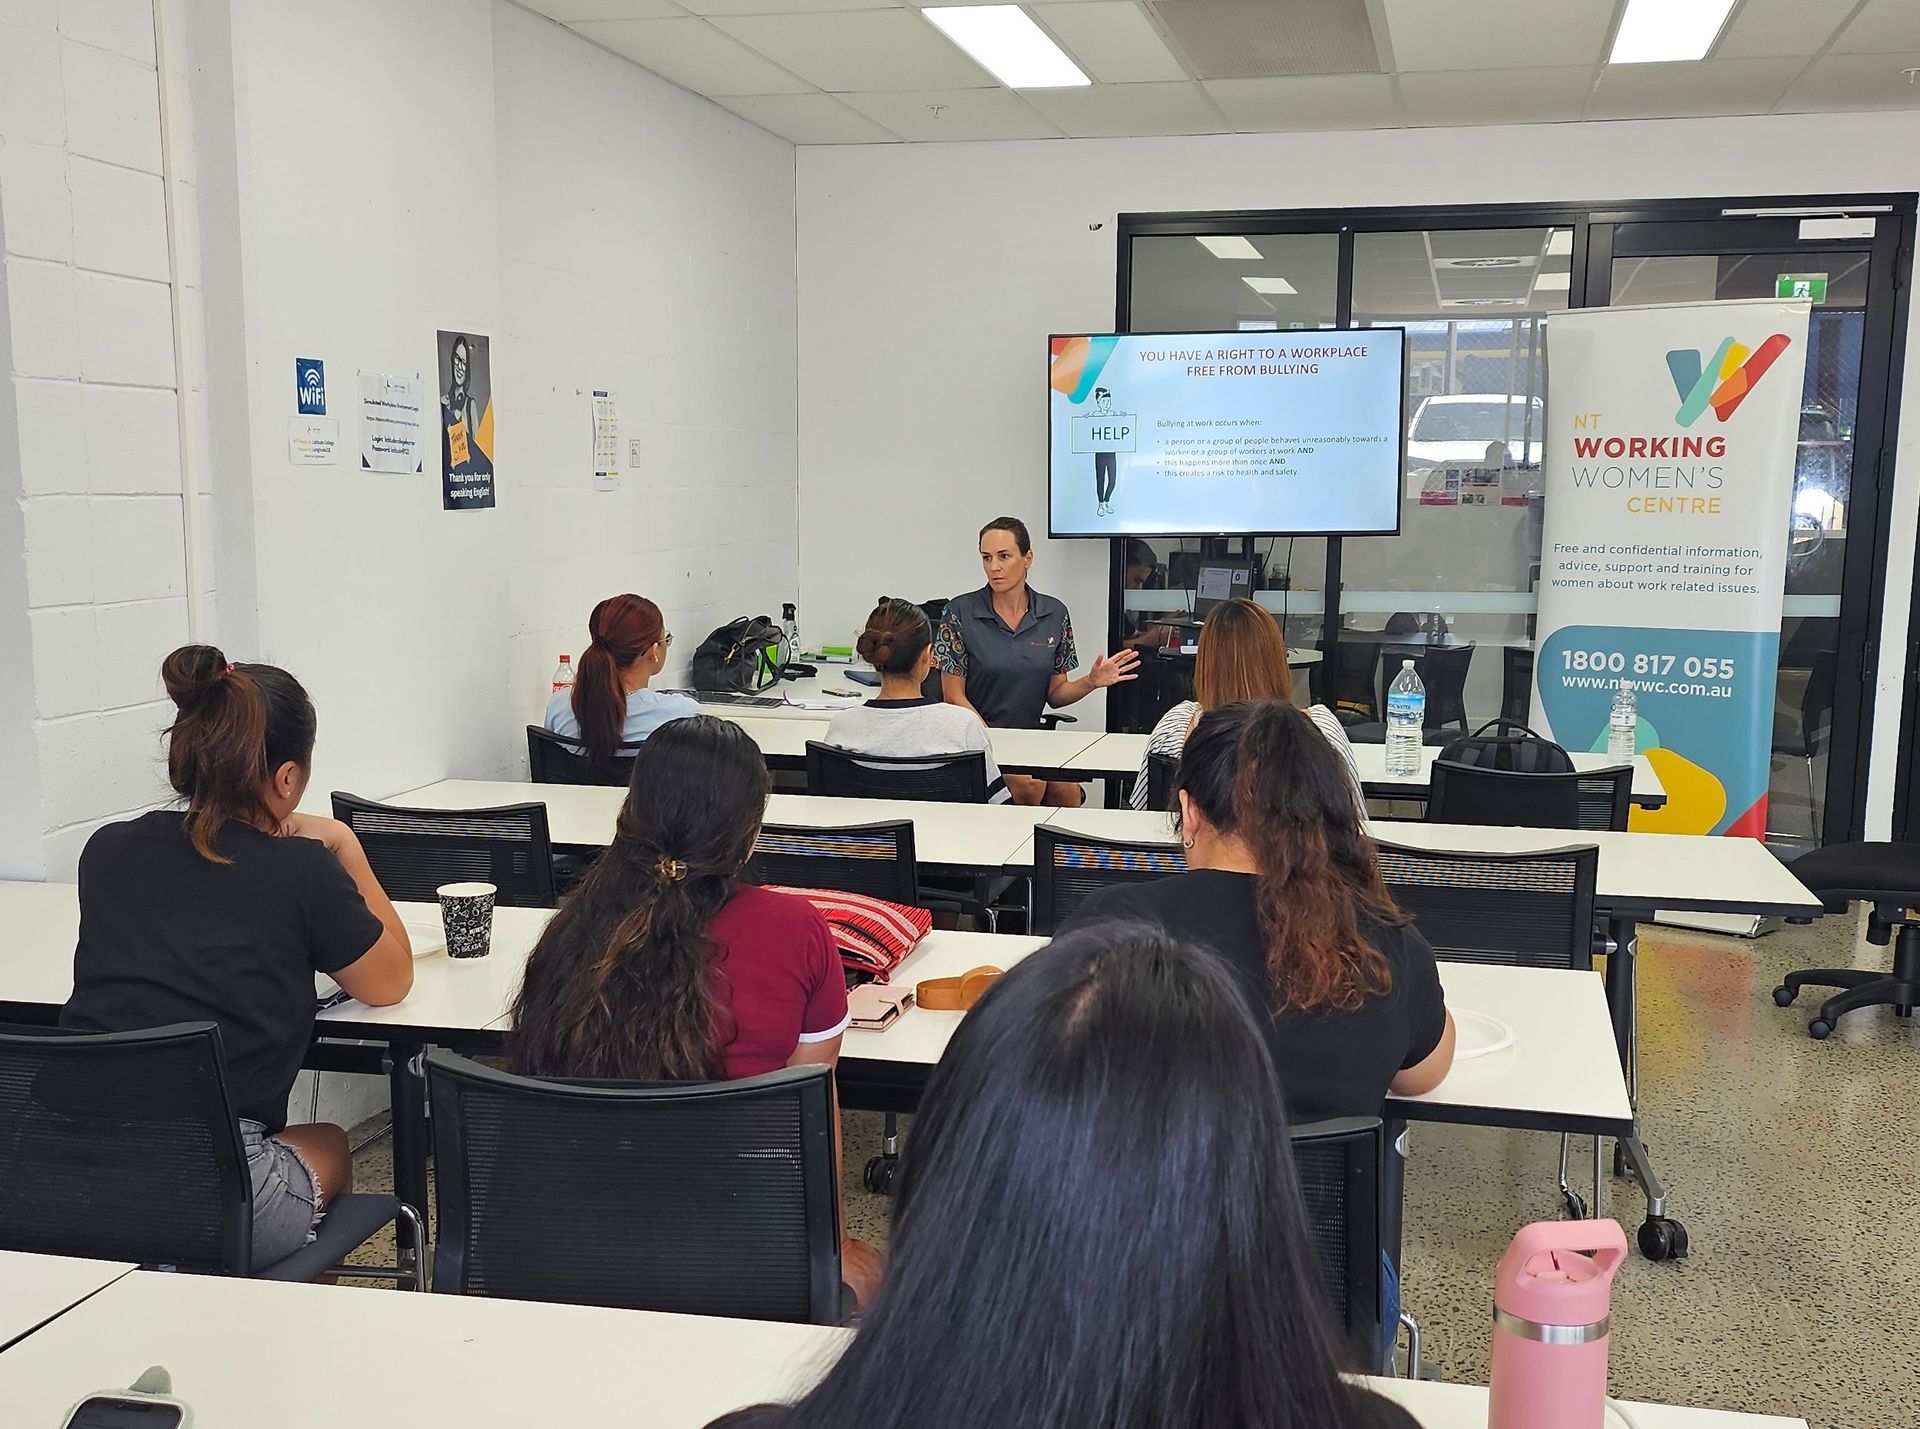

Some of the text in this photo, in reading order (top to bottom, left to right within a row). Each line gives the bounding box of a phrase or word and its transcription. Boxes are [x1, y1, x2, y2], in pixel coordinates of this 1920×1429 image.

[1139, 346, 1368, 361] YOU HAVE A RIGHT TO A WORKPLACE
[1187, 364, 1319, 376] FREE FROM BULLYING
[300, 386, 325, 405] WiFi
[1157, 420, 1185, 428] Bullying
[1195, 419, 1215, 427] work
[1574, 414, 1602, 429] NT
[1091, 426, 1130, 441] HELP
[1244, 437, 1268, 446] people
[1302, 436, 1350, 444] unreasonably
[1352, 435, 1382, 443] towards
[1574, 436, 1726, 458] WORKING
[1179, 459, 1210, 467] happens
[449, 472, 491, 484] Thank you for only
[1275, 468, 1299, 476] safety.
[1571, 466, 1724, 489] WOMEN’S
[450, 486, 490, 499] speaking English!
[1627, 496, 1721, 514] CENTRE
[1554, 543, 1763, 560] Free and confidential information,
[1559, 561, 1754, 576] advice, support and training for
[1552, 579, 1760, 594] women about work related issues.
[1562, 650, 1735, 680] 1800 817 055
[1562, 676, 1733, 698] www.nwwc.com.au
